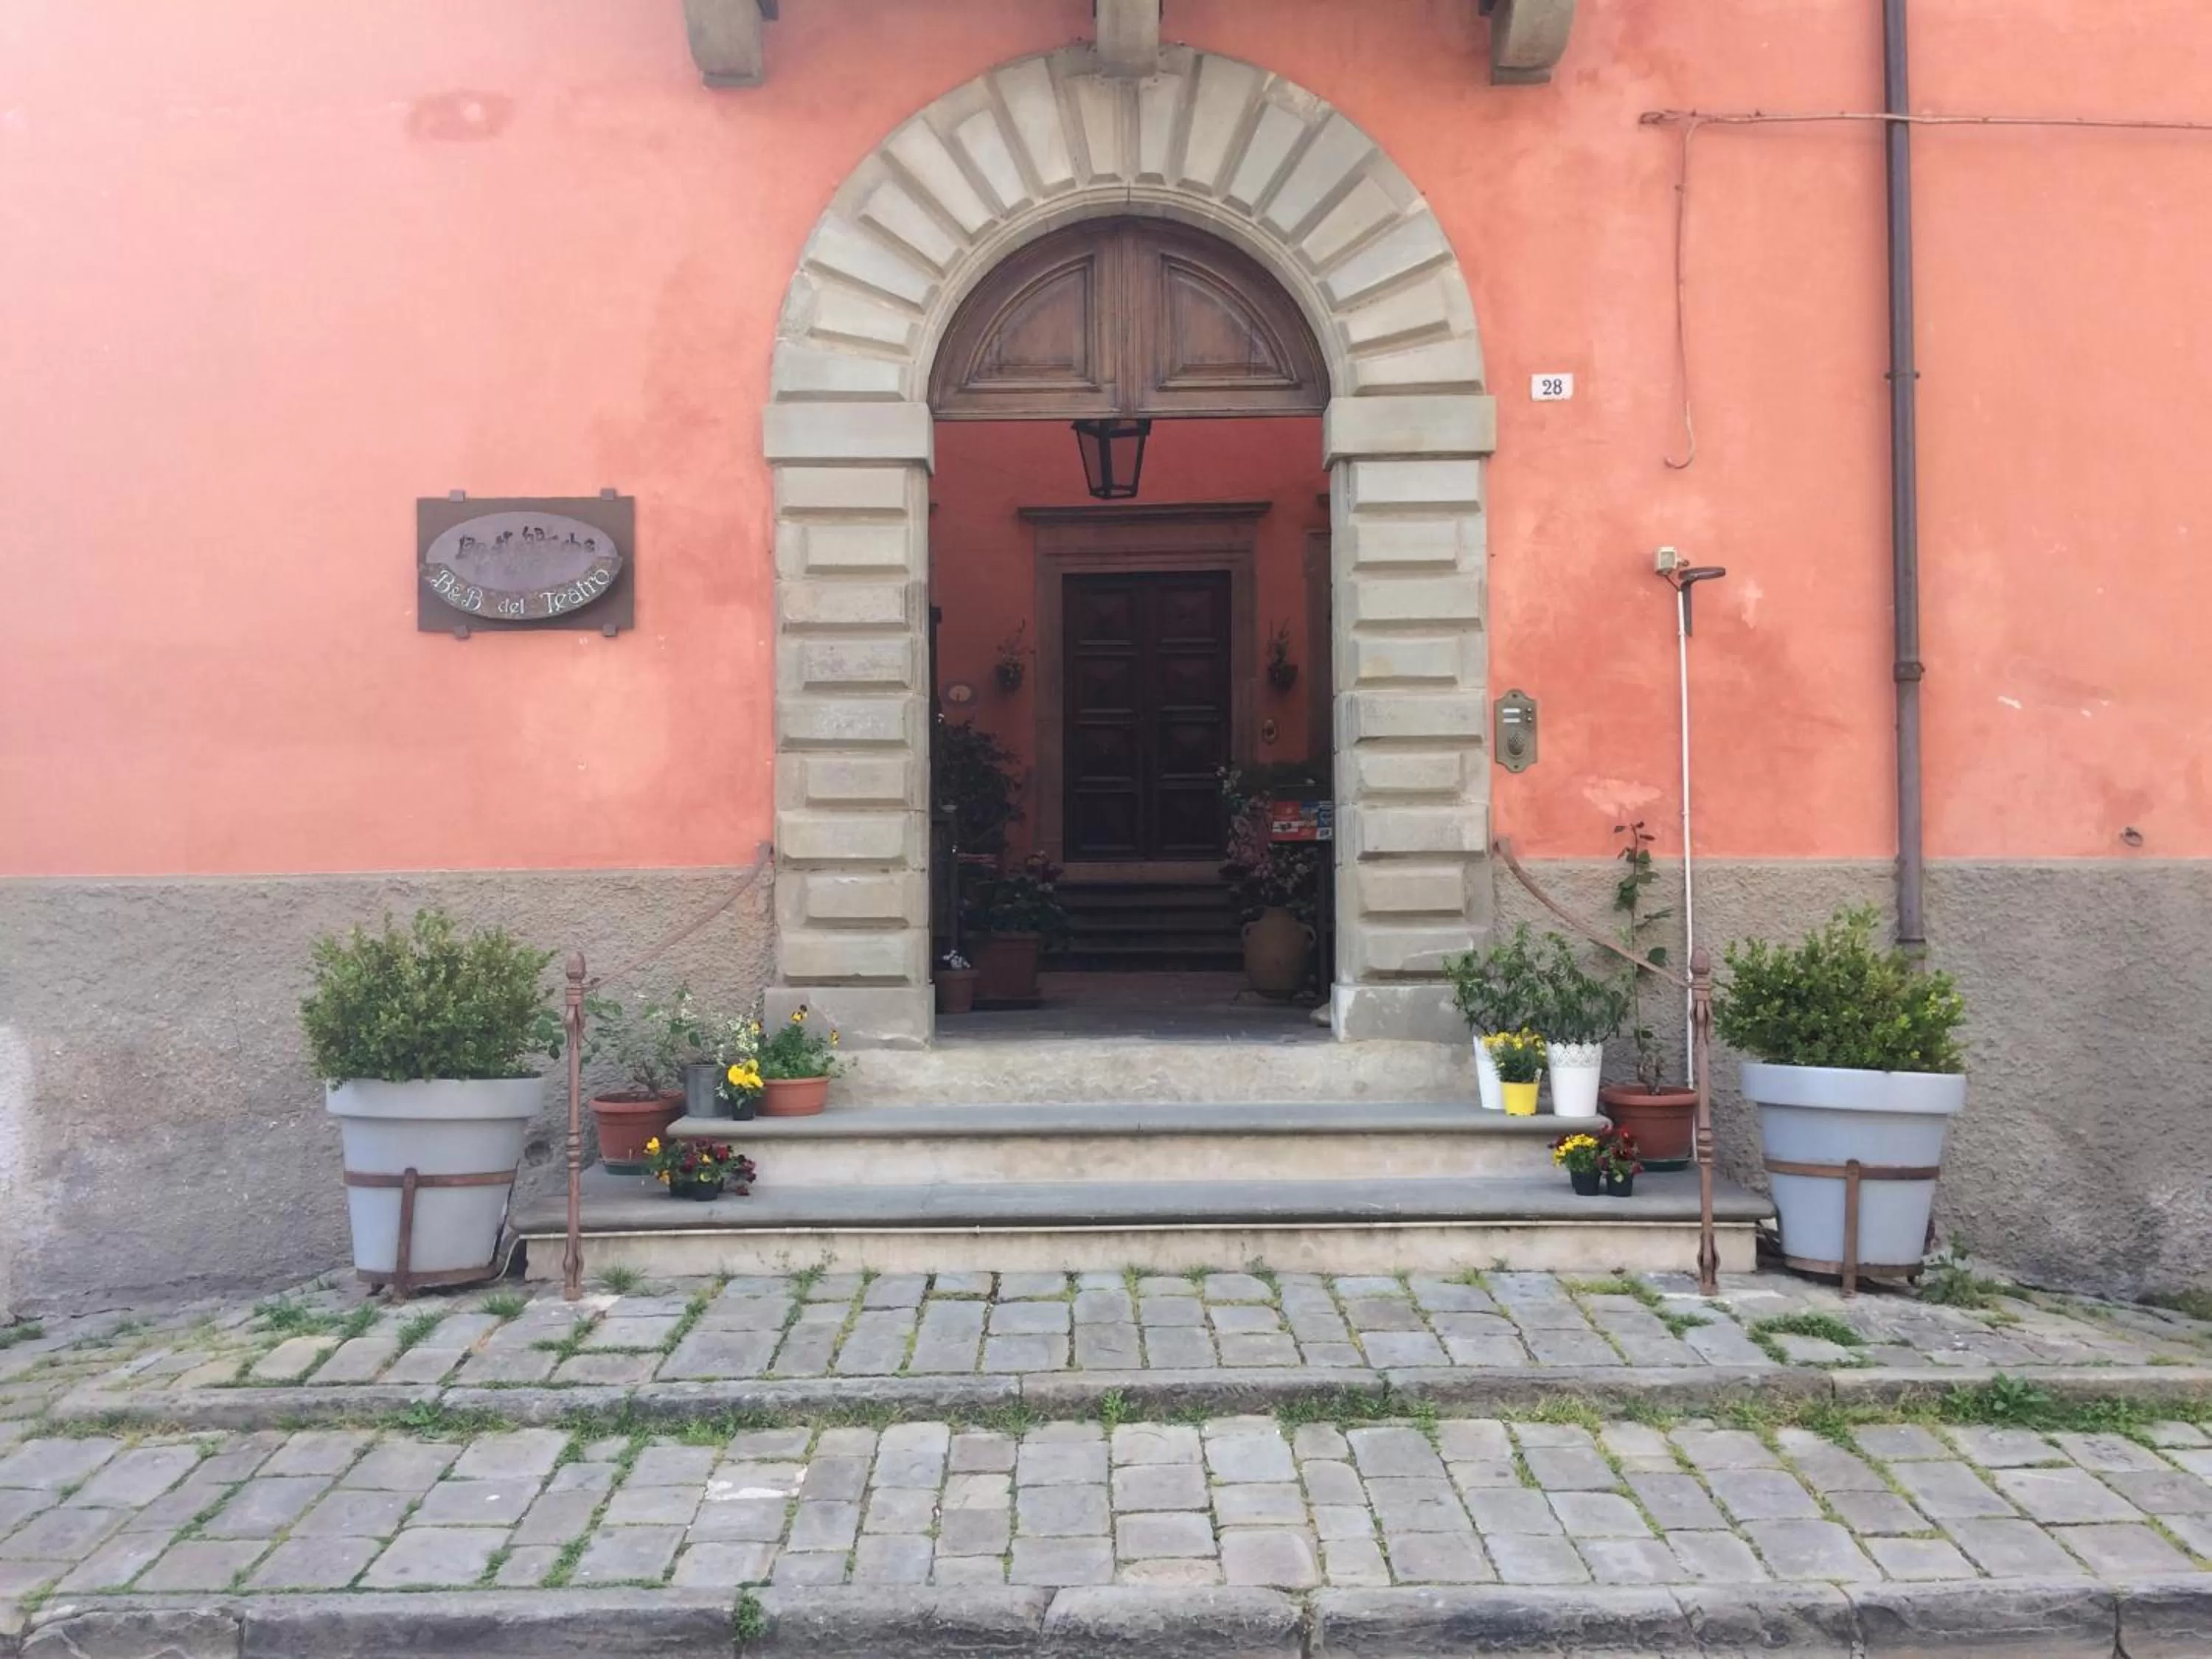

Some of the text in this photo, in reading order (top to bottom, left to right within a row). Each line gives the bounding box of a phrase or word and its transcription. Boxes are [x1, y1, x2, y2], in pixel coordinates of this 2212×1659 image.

[1543, 378, 1562, 395] 28
[431, 568, 611, 614] B&B del Teatro
